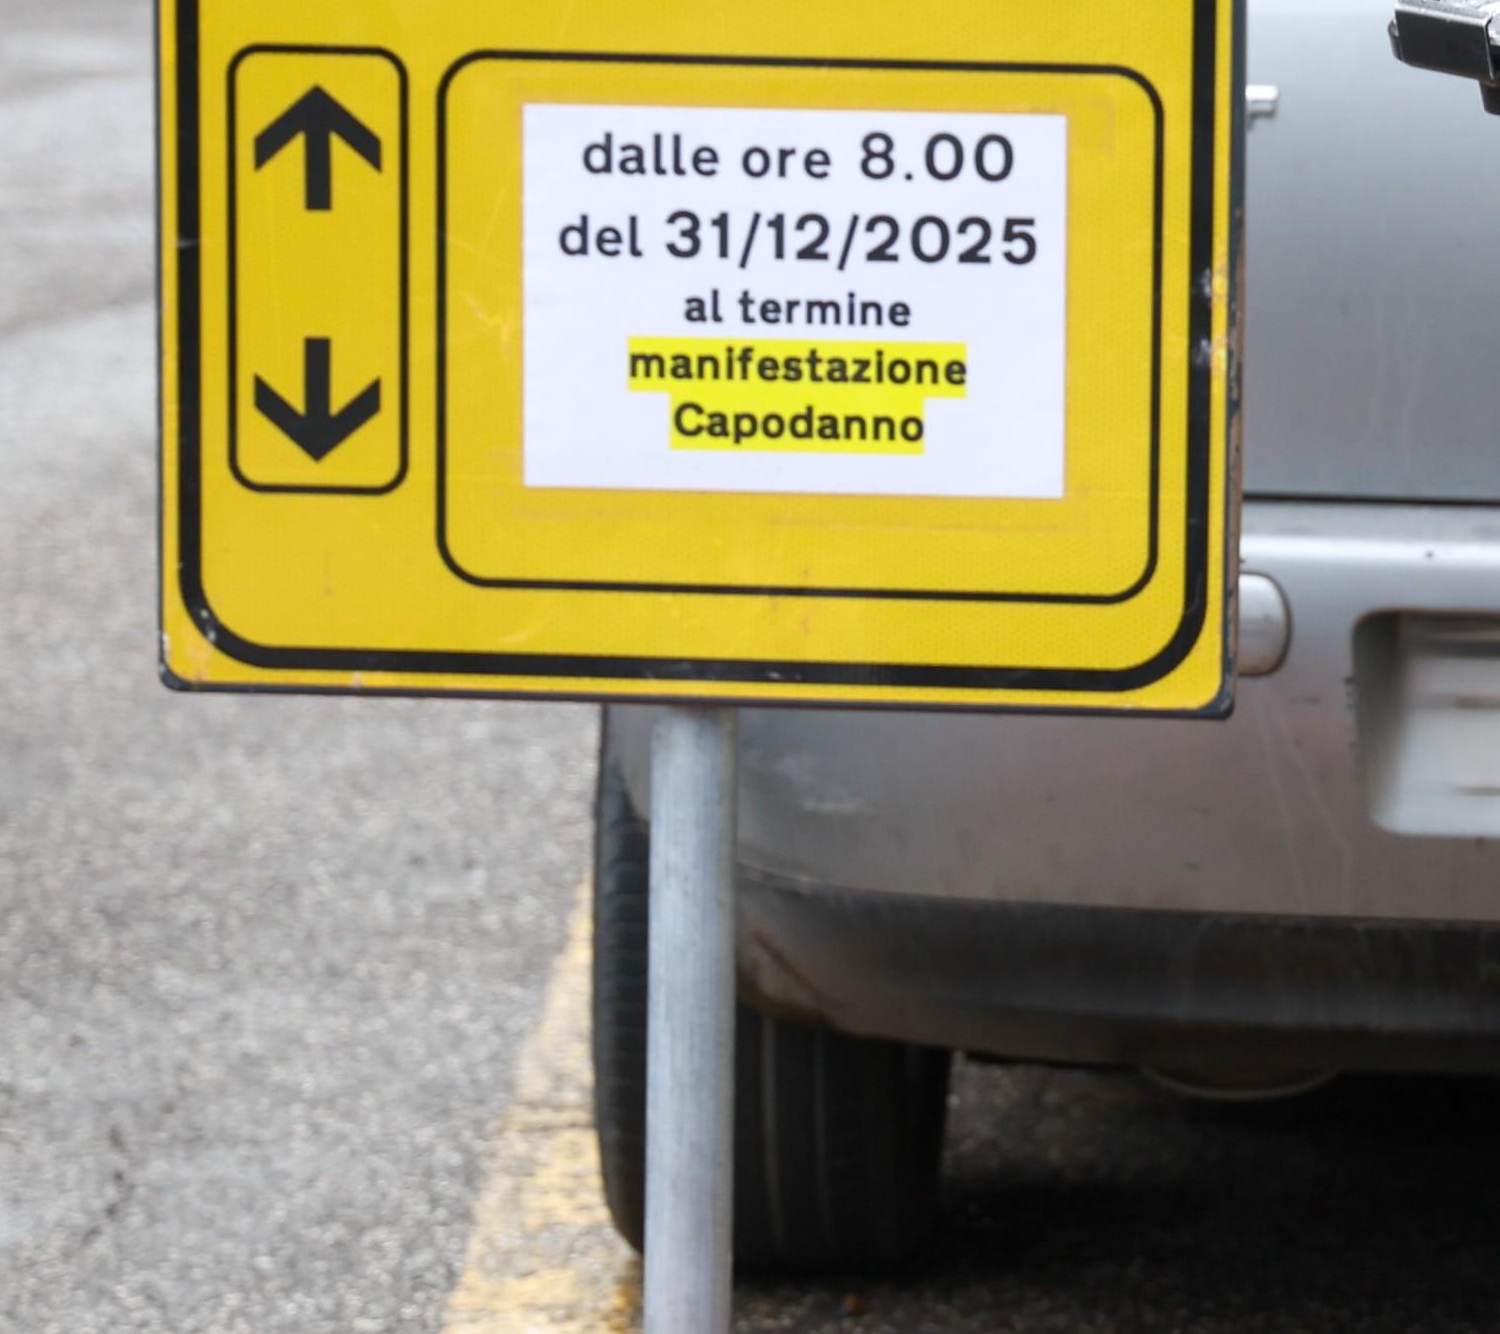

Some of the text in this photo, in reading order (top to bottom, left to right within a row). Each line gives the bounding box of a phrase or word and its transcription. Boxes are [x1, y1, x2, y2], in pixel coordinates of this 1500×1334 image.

[583, 132, 1013, 182] dalle ore 8.00
[560, 210, 1036, 271] del 31/12/2025
[685, 289, 910, 327] al termine
[631, 347, 966, 386] manifestazione
[674, 402, 924, 445] Capodanno
